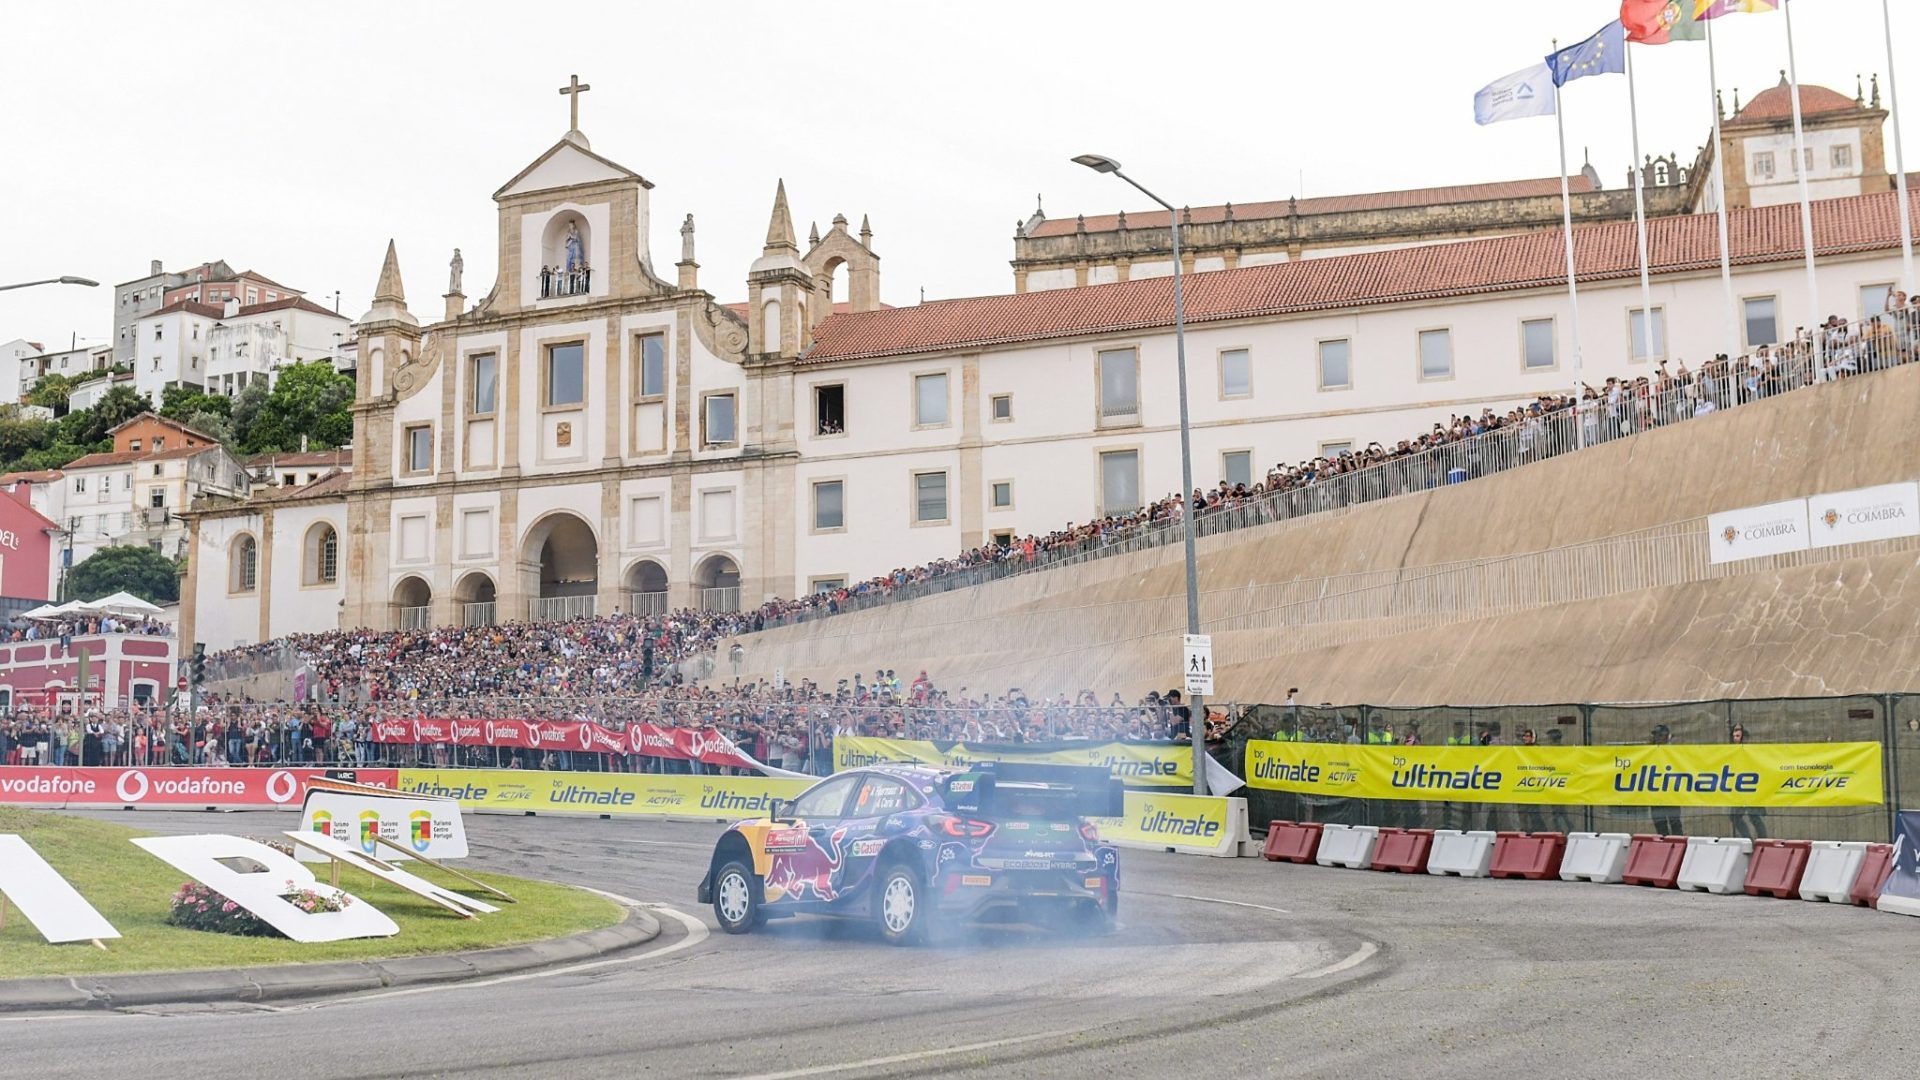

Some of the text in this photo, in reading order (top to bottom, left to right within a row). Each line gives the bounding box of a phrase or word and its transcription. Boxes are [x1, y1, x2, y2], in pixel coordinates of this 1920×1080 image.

[1848, 507, 1905, 524] COIMBRA
[1744, 523, 1797, 541] COIMBRA
[420, 725, 442, 737] vodafone
[495, 725, 518, 739] vodafone
[540, 728, 566, 742] vodafone
[1254, 749, 1265, 759] bp
[1393, 755, 1406, 769] bp
[1615, 756, 1631, 770] bp
[1796, 763, 1834, 772] tecnologia
[1254, 757, 1320, 783] ultimate
[1328, 771, 1357, 782] ACTIVE
[402, 776, 413, 785] bp
[552, 779, 563, 788] bp
[1391, 764, 1502, 790] ultimate
[1516, 777, 1568, 788] ACTIVE
[1614, 765, 1759, 793] ultimate
[1781, 776, 1850, 788] ACTIVE
[1, 775, 96, 793] vodafone
[154, 776, 245, 795] vodafone
[703, 784, 714, 794] bp
[497, 791, 532, 800] ACTIVE
[550, 785, 636, 805] ultimate
[647, 797, 683, 805] ACTIVE
[1143, 802, 1154, 813] bp
[1140, 810, 1220, 837] ultimate
[433, 833, 453, 841] Portugal
